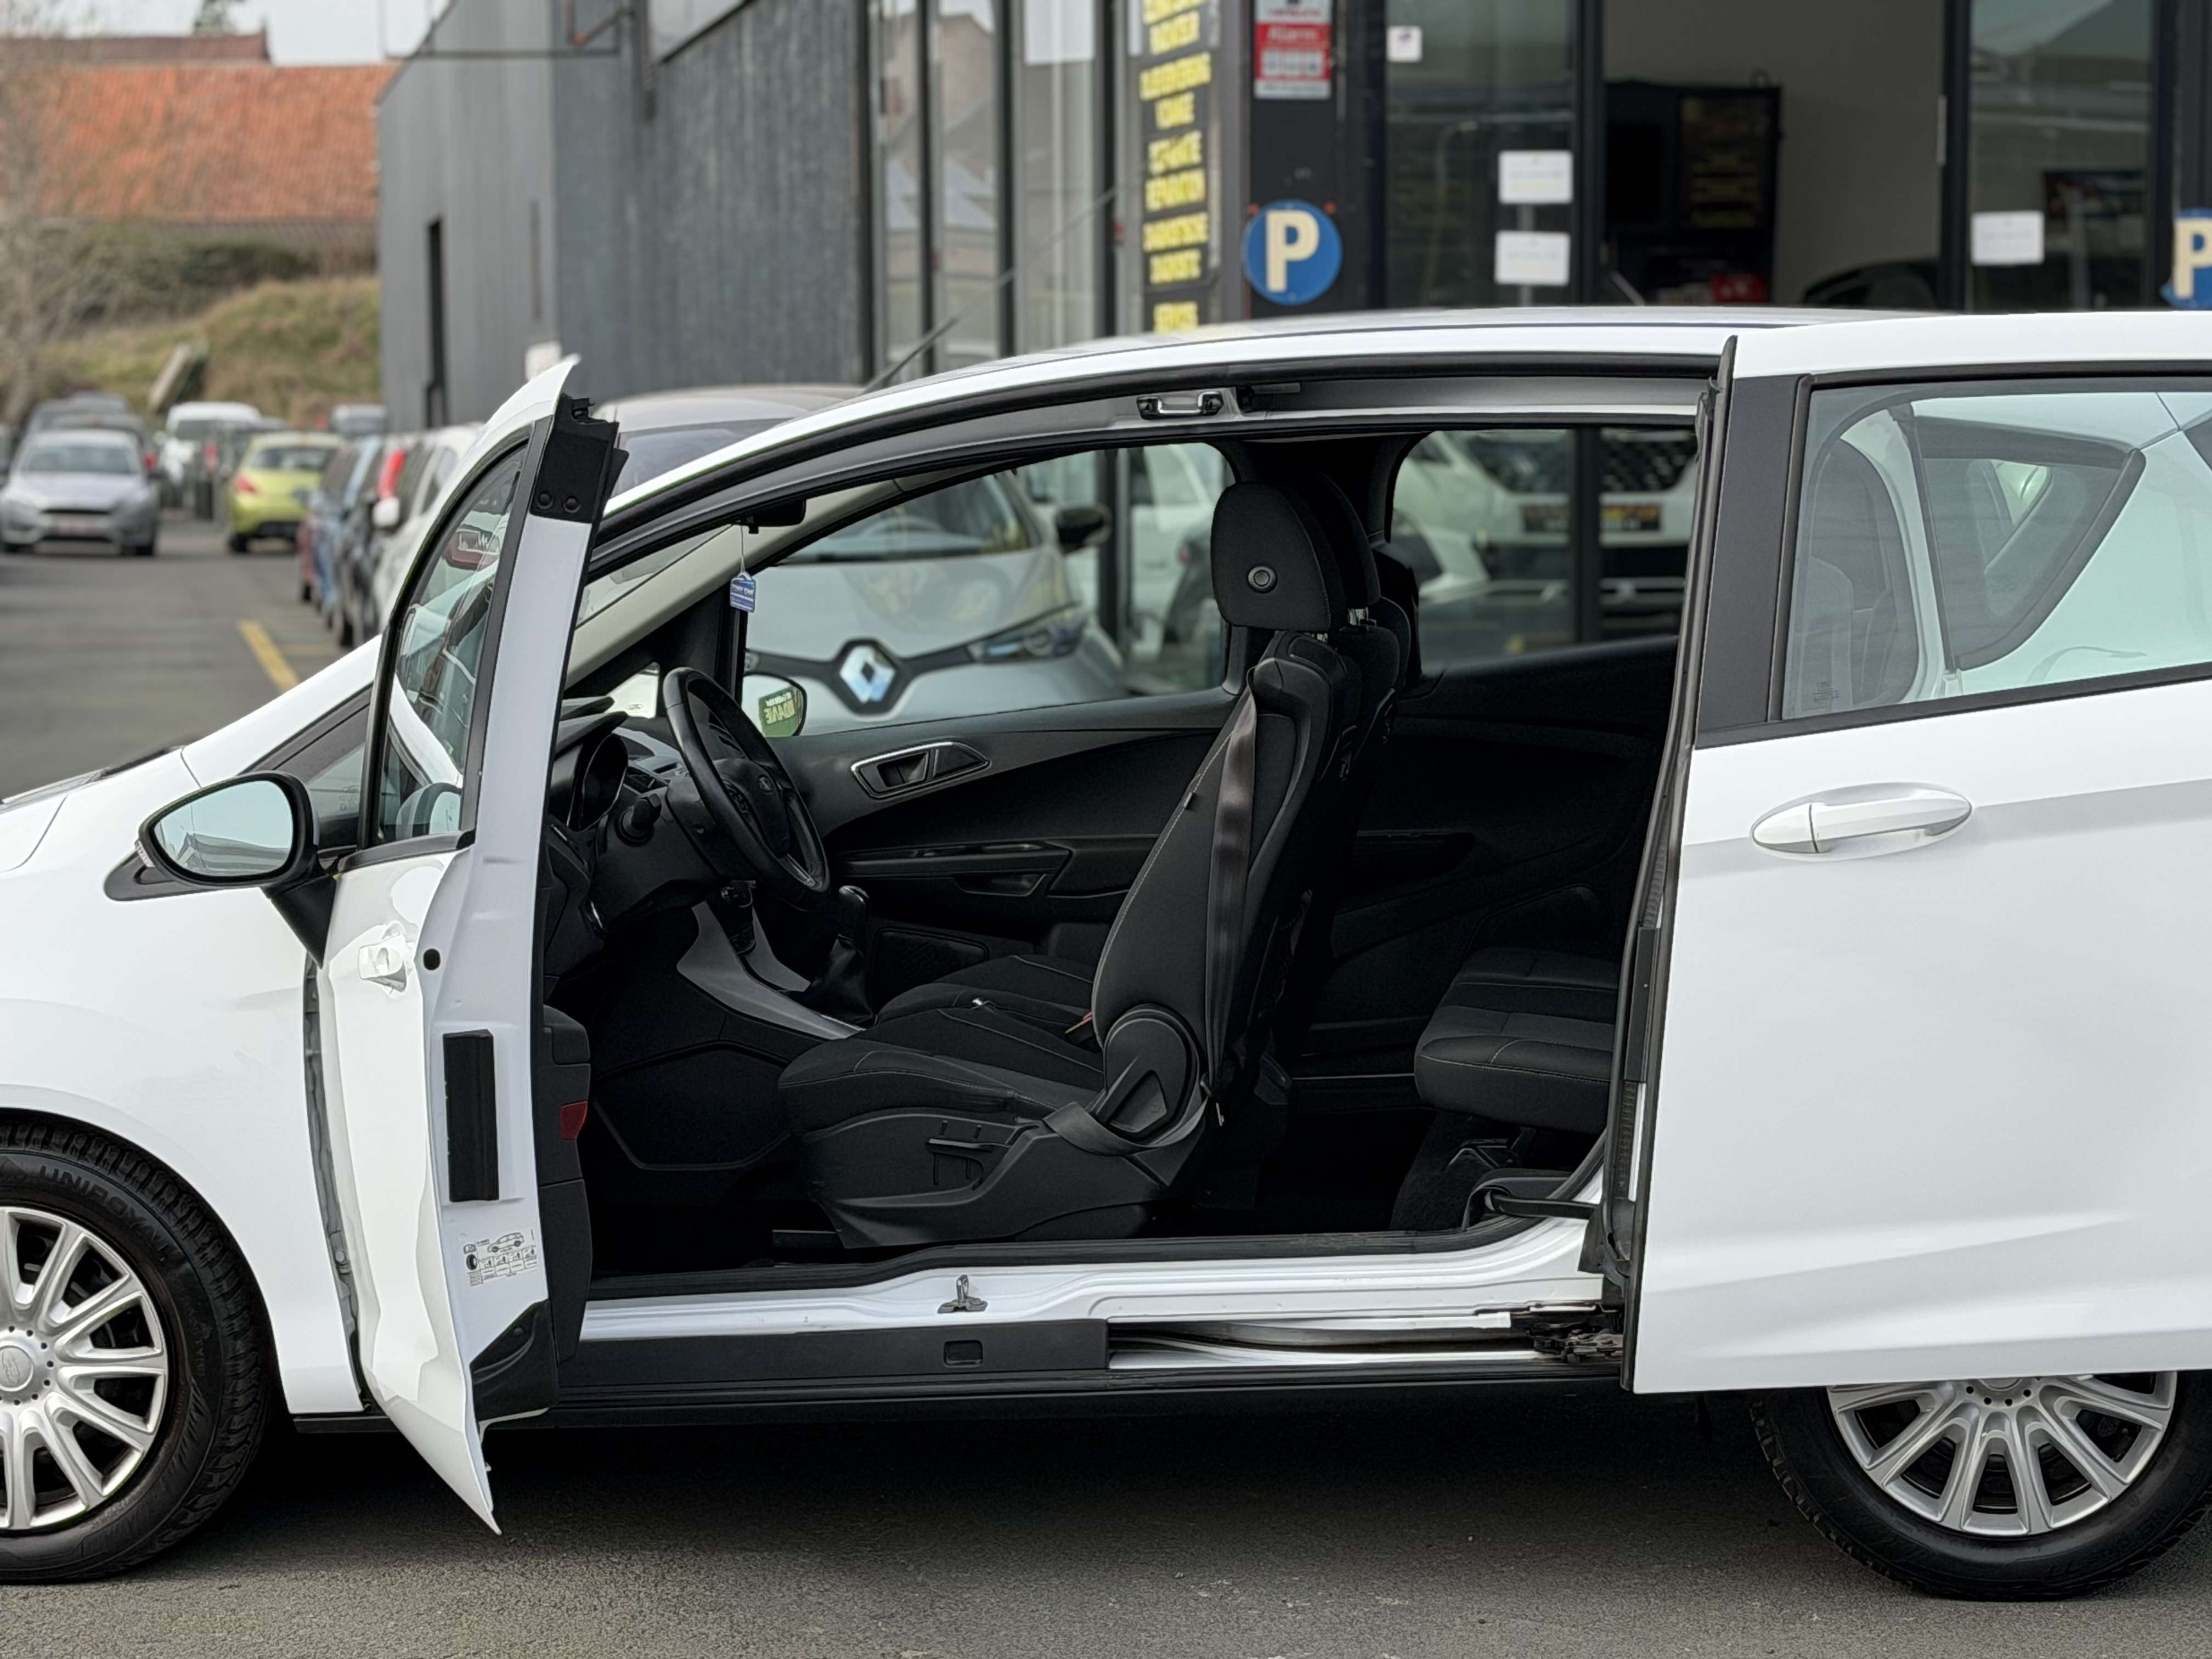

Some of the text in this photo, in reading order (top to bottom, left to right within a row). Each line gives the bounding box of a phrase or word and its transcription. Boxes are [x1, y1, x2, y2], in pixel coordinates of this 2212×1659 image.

[1265, 210, 1320, 293] P
[2174, 218, 2212, 298] P
[38, 1164, 169, 1263] UNIROYAL
